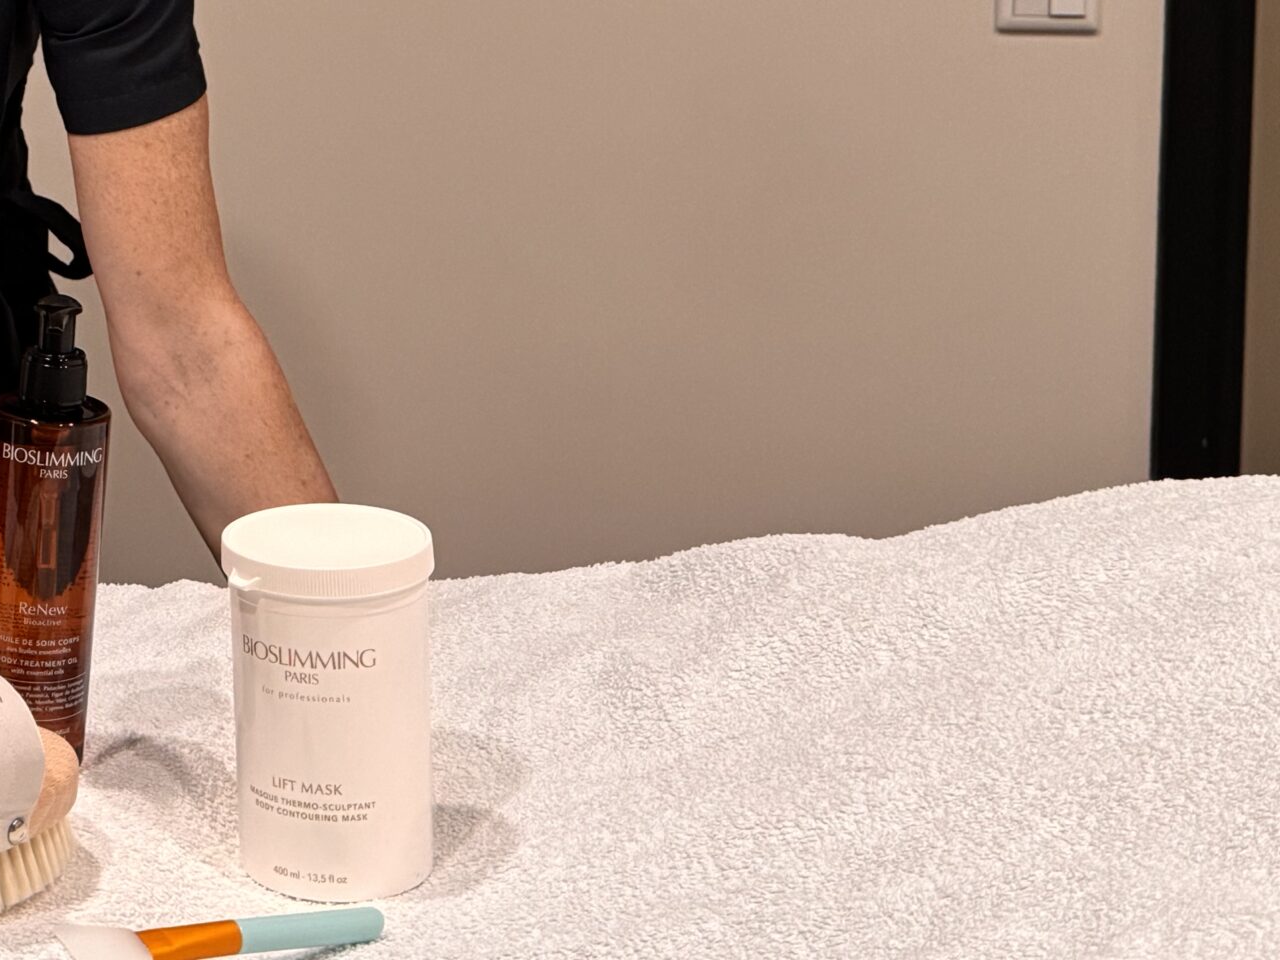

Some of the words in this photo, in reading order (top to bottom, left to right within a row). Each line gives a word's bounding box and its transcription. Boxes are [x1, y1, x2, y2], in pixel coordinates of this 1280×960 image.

[2, 442, 102, 467] BIOSLIMMING
[40, 469, 68, 479] PARIS
[19, 602, 68, 616] ReNew
[24, 617, 62, 626] Bioactive
[36, 639, 56, 647] SOIN
[58, 635, 80, 646] CORPS
[242, 634, 377, 671] BIOSLIMMING
[19, 659, 66, 668] TREATMENT
[284, 670, 320, 686] PARIS
[262, 685, 275, 695] for
[278, 691, 351, 704] professionals
[272, 776, 296, 791] LIFT
[301, 782, 343, 796] MASK
[250, 784, 279, 803] MASQUE
[281, 797, 376, 812] THERMO-SCULPTANT
[255, 798, 274, 812] BODY
[276, 807, 338, 823] CONTOURING
[341, 813, 368, 822] MASK
[273, 865, 289, 877] 400
[290, 870, 300, 879] ml
[307, 873, 326, 884] 13,5
[328, 874, 335, 883] fl
[336, 876, 348, 884] oz
